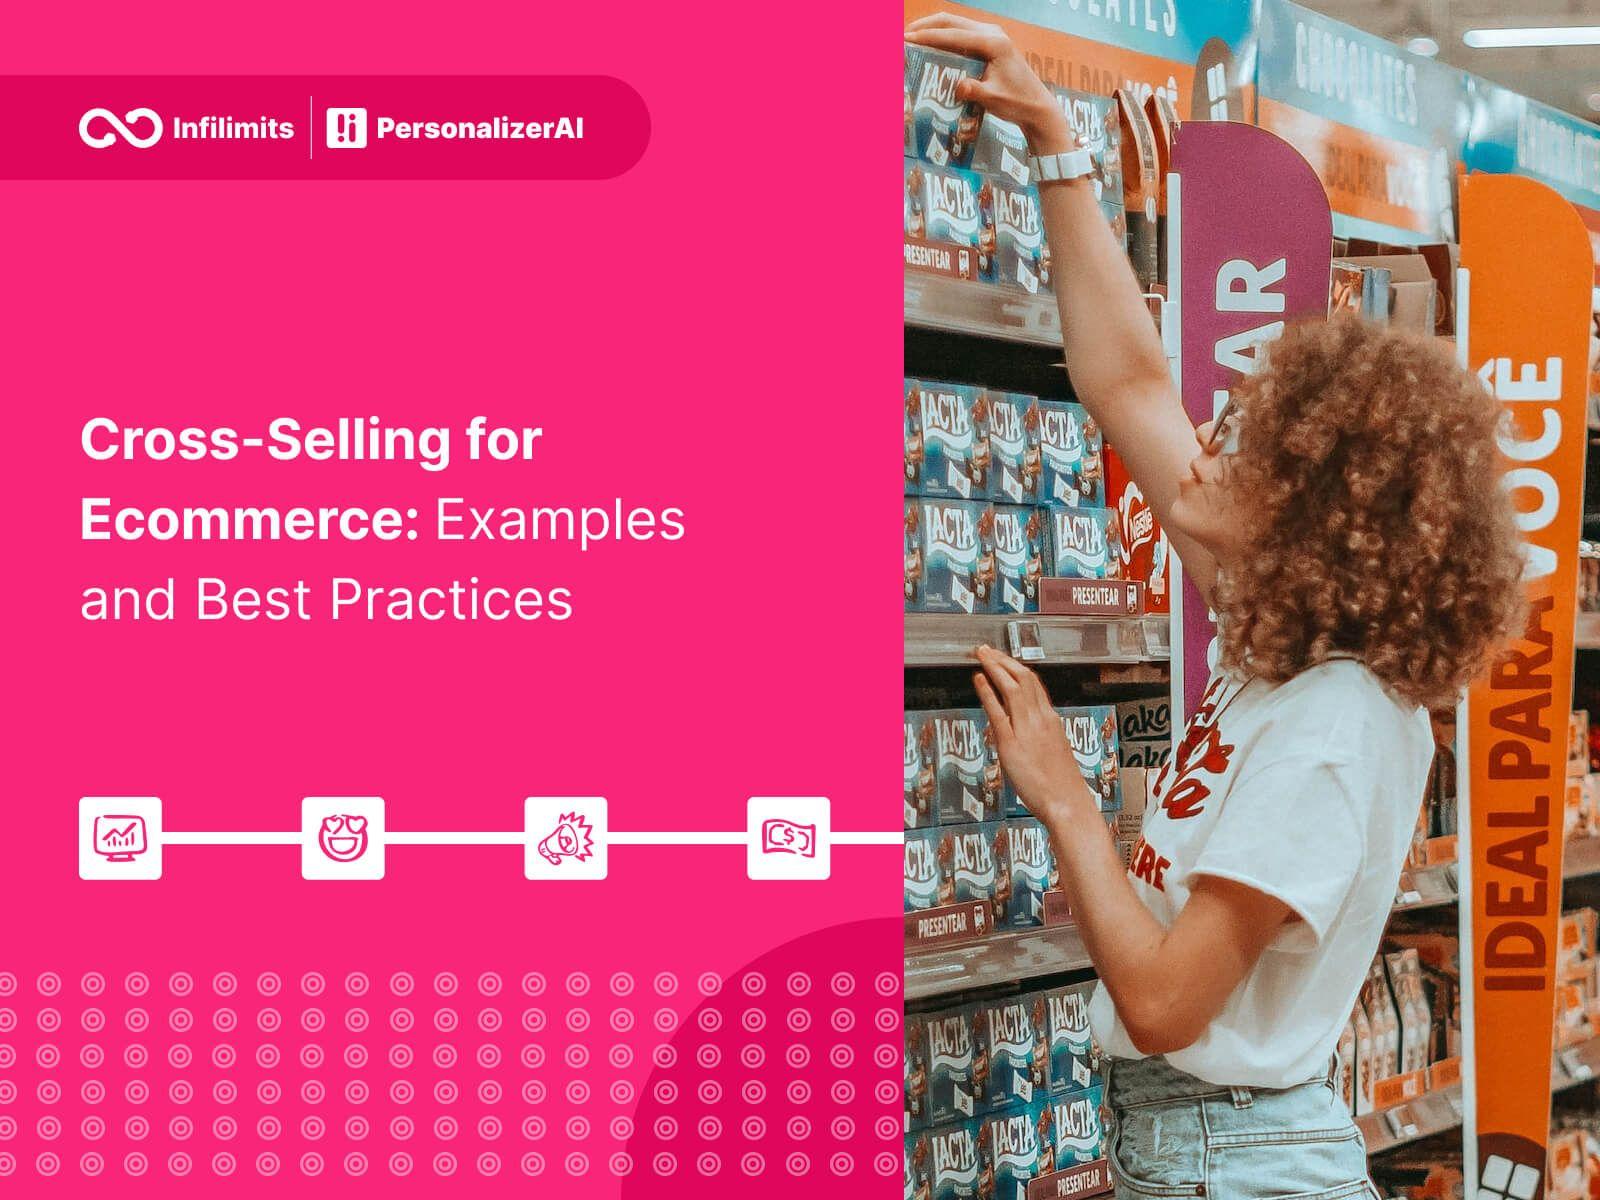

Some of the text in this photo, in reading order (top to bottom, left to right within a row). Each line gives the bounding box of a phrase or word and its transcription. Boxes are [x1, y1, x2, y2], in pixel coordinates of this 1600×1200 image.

[924, 172, 977, 224] LACTA
[904, 243, 951, 270] RESENTEAR
[920, 392, 970, 439] LACTA
[924, 505, 975, 551] LACTA
[993, 513, 1024, 551] CTA
[1055, 513, 1103, 556] LACTA
[1072, 586, 1120, 606] PRESENTEAR
[935, 719, 982, 763] LACTA
[905, 839, 936, 881] CTA
[1007, 828, 1046, 870] LACTA
[1483, 795, 1551, 992] IDEAL
[918, 912, 968, 939] PRESENTEAR
[988, 1004, 1032, 1052] LACTA
[1049, 993, 1089, 1038] LACTA
[928, 1015, 970, 1062] LACTA
[992, 1114, 1036, 1161] LACTA
[1054, 1099, 1097, 1146] LACTA
[932, 1129, 977, 1178] LACTA
[1057, 1169, 1101, 1198] PRESENTEAR
